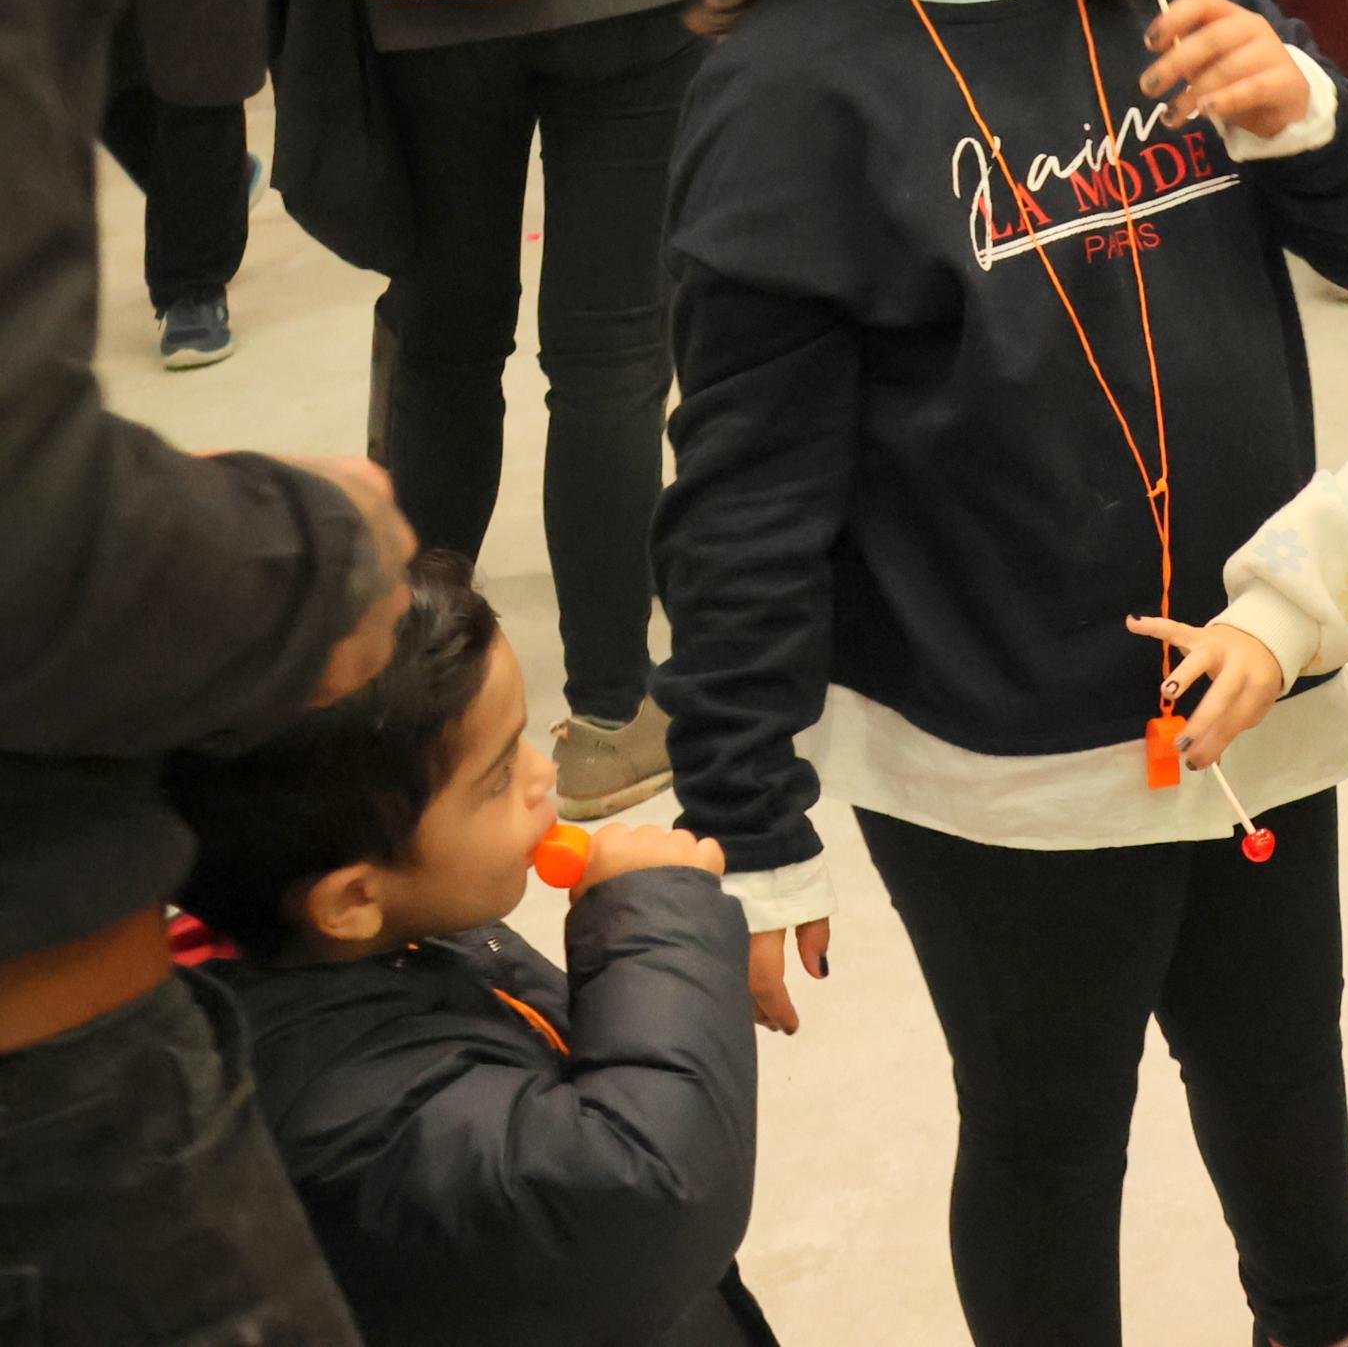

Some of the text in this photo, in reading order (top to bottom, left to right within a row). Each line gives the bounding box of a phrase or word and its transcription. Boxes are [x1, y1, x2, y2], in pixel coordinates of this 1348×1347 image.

[952, 84, 1200, 273] J'aim
[1068, 130, 1214, 213] MODE
[1085, 222, 1161, 264] PARIS
